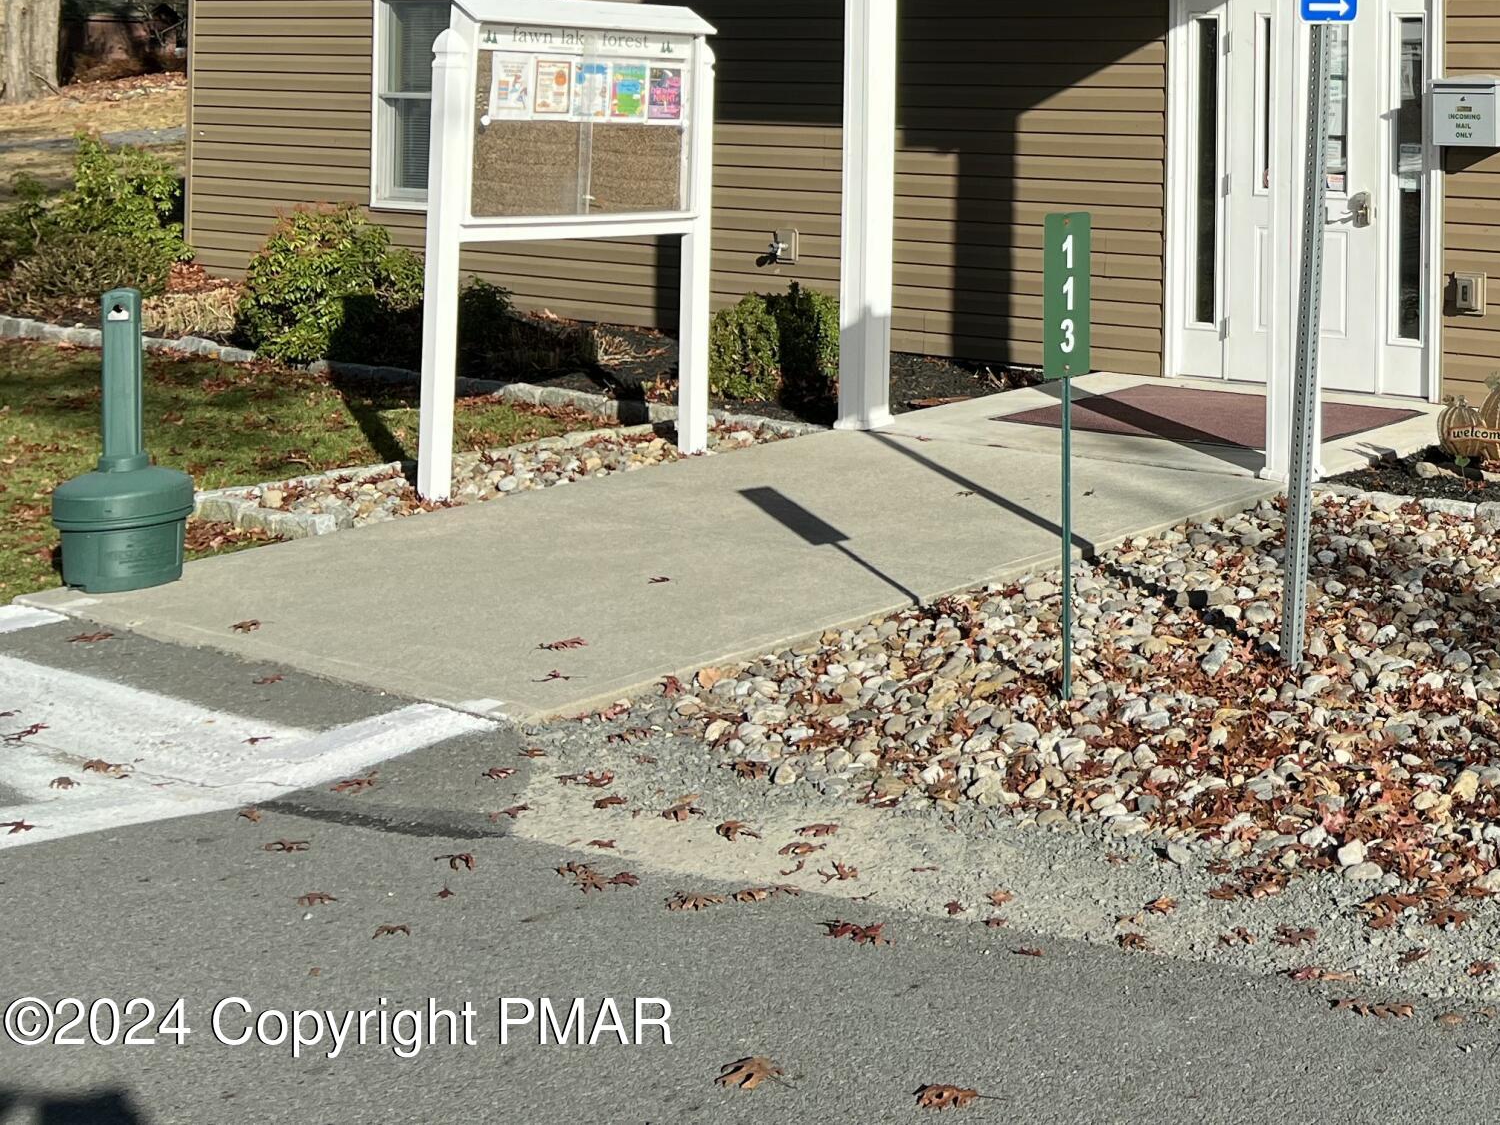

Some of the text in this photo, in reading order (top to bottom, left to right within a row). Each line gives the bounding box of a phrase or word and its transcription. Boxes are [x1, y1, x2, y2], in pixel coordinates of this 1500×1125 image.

[512, 27, 553, 44] fawn
[602, 31, 649, 49] forest
[1448, 113, 1482, 121] INCOMING
[1060, 234, 1075, 354] 113
